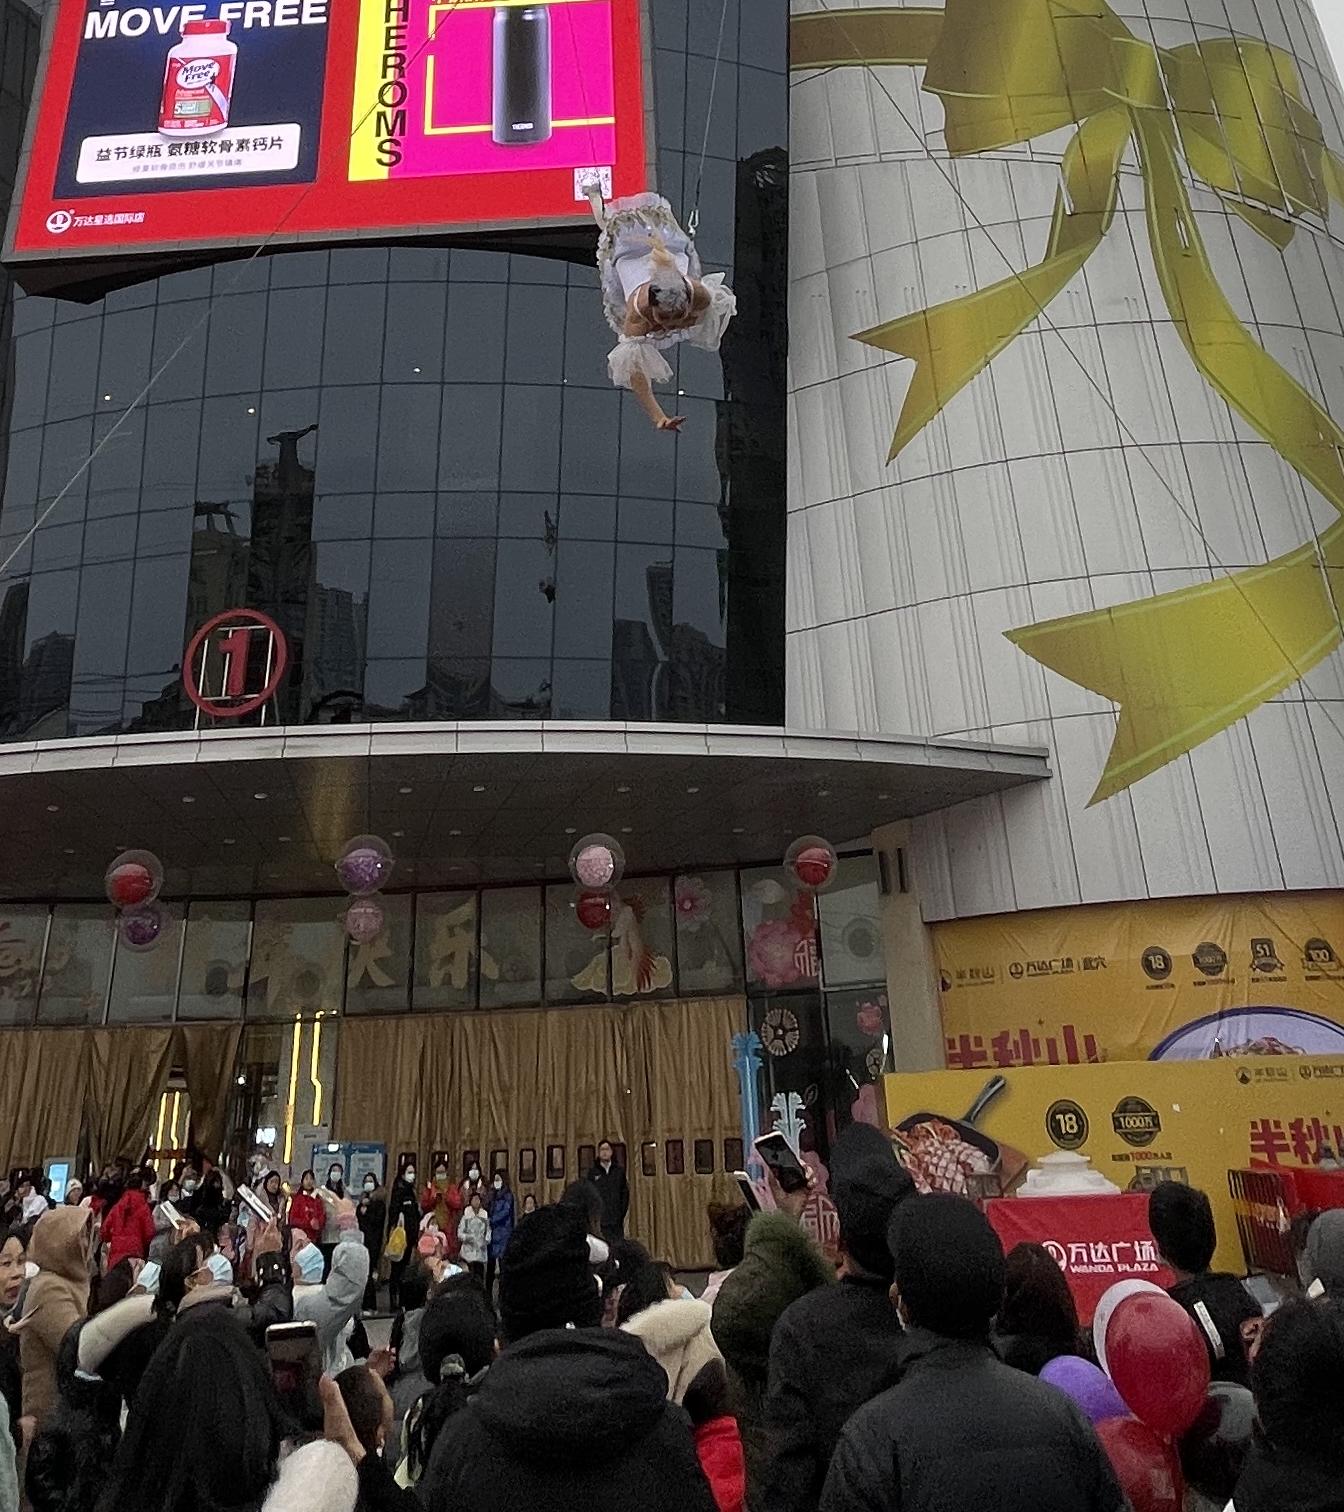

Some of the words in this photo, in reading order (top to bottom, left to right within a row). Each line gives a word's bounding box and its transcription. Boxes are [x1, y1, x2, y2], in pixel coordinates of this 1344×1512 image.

[84, 3, 207, 40] MOVE
[181, 61, 216, 76] Move
[184, 70, 211, 83] Free
[96, 145, 163, 162] 益节绿瓶
[167, 136, 284, 157] 氨糖软骨素钙片
[1026, 956, 1074, 974] 万达广场
[1148, 954, 1164, 970] 18
[1056, 1112, 1079, 1135] 18
[1119, 1116, 1155, 1129] 1000万
[1067, 1240, 1157, 1264] 万达广场
[1070, 1264, 1115, 1274] WANDA
[1117, 1262, 1159, 1273] PLAZA
